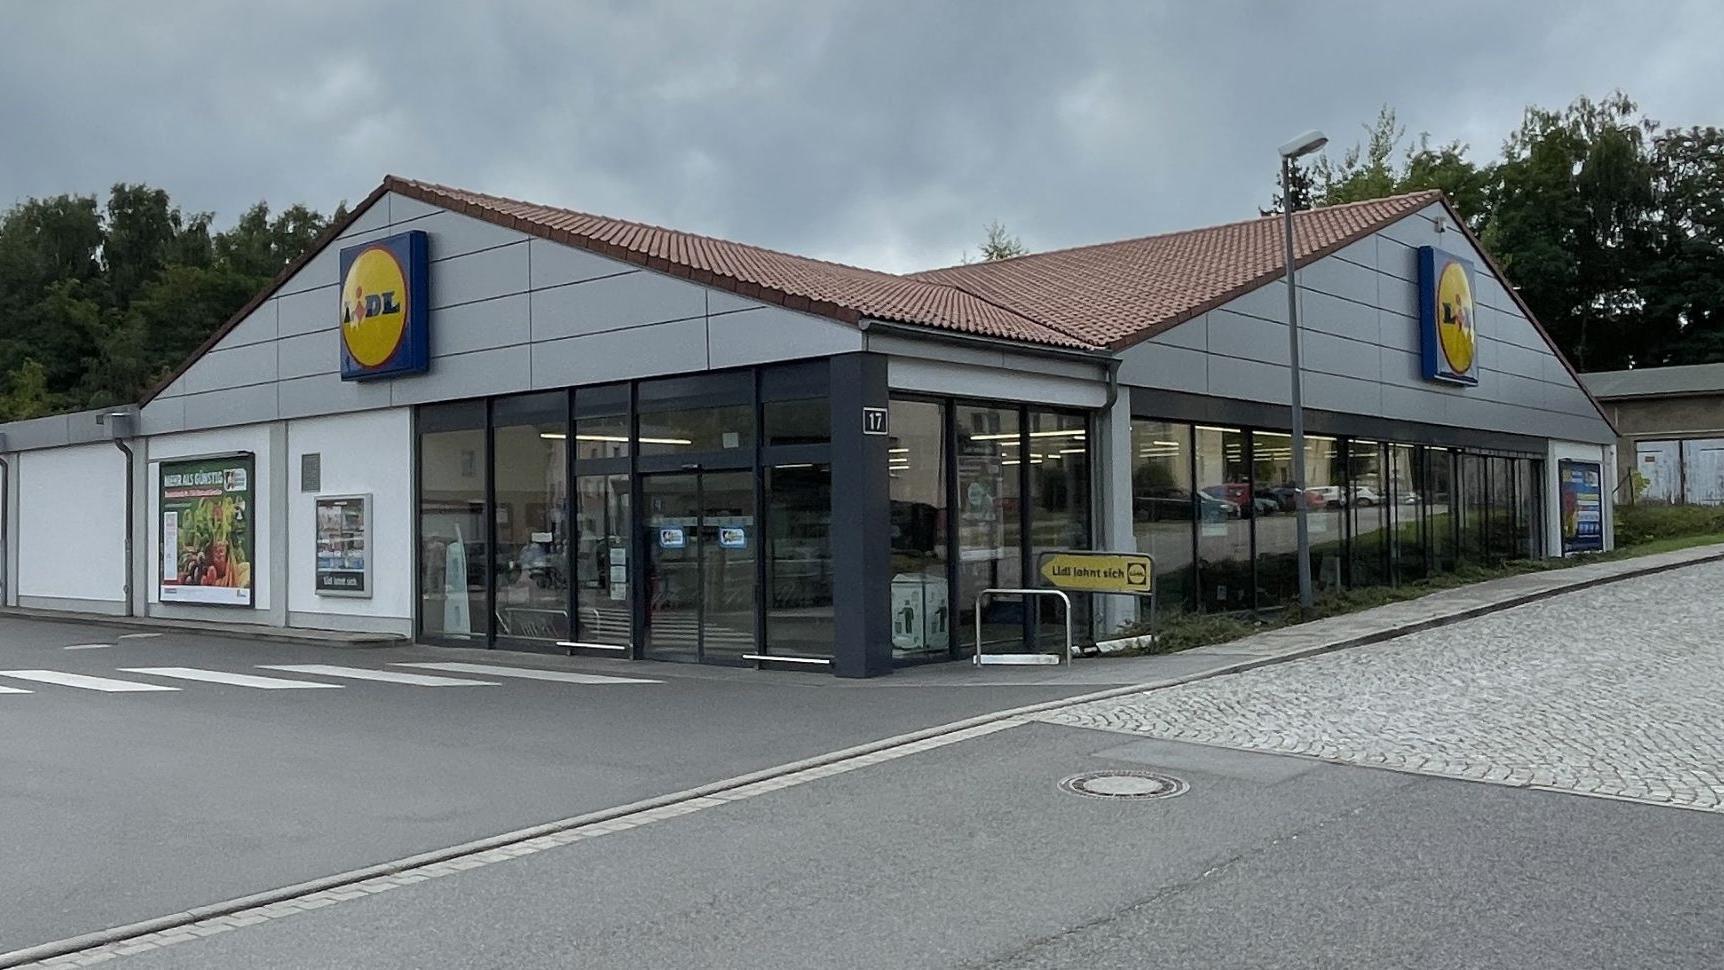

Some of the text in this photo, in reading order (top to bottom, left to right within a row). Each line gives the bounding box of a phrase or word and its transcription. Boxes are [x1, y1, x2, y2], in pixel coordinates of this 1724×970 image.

[869, 412, 882, 430] 17
[1052, 565, 1125, 579] Lidl lohnt sich
